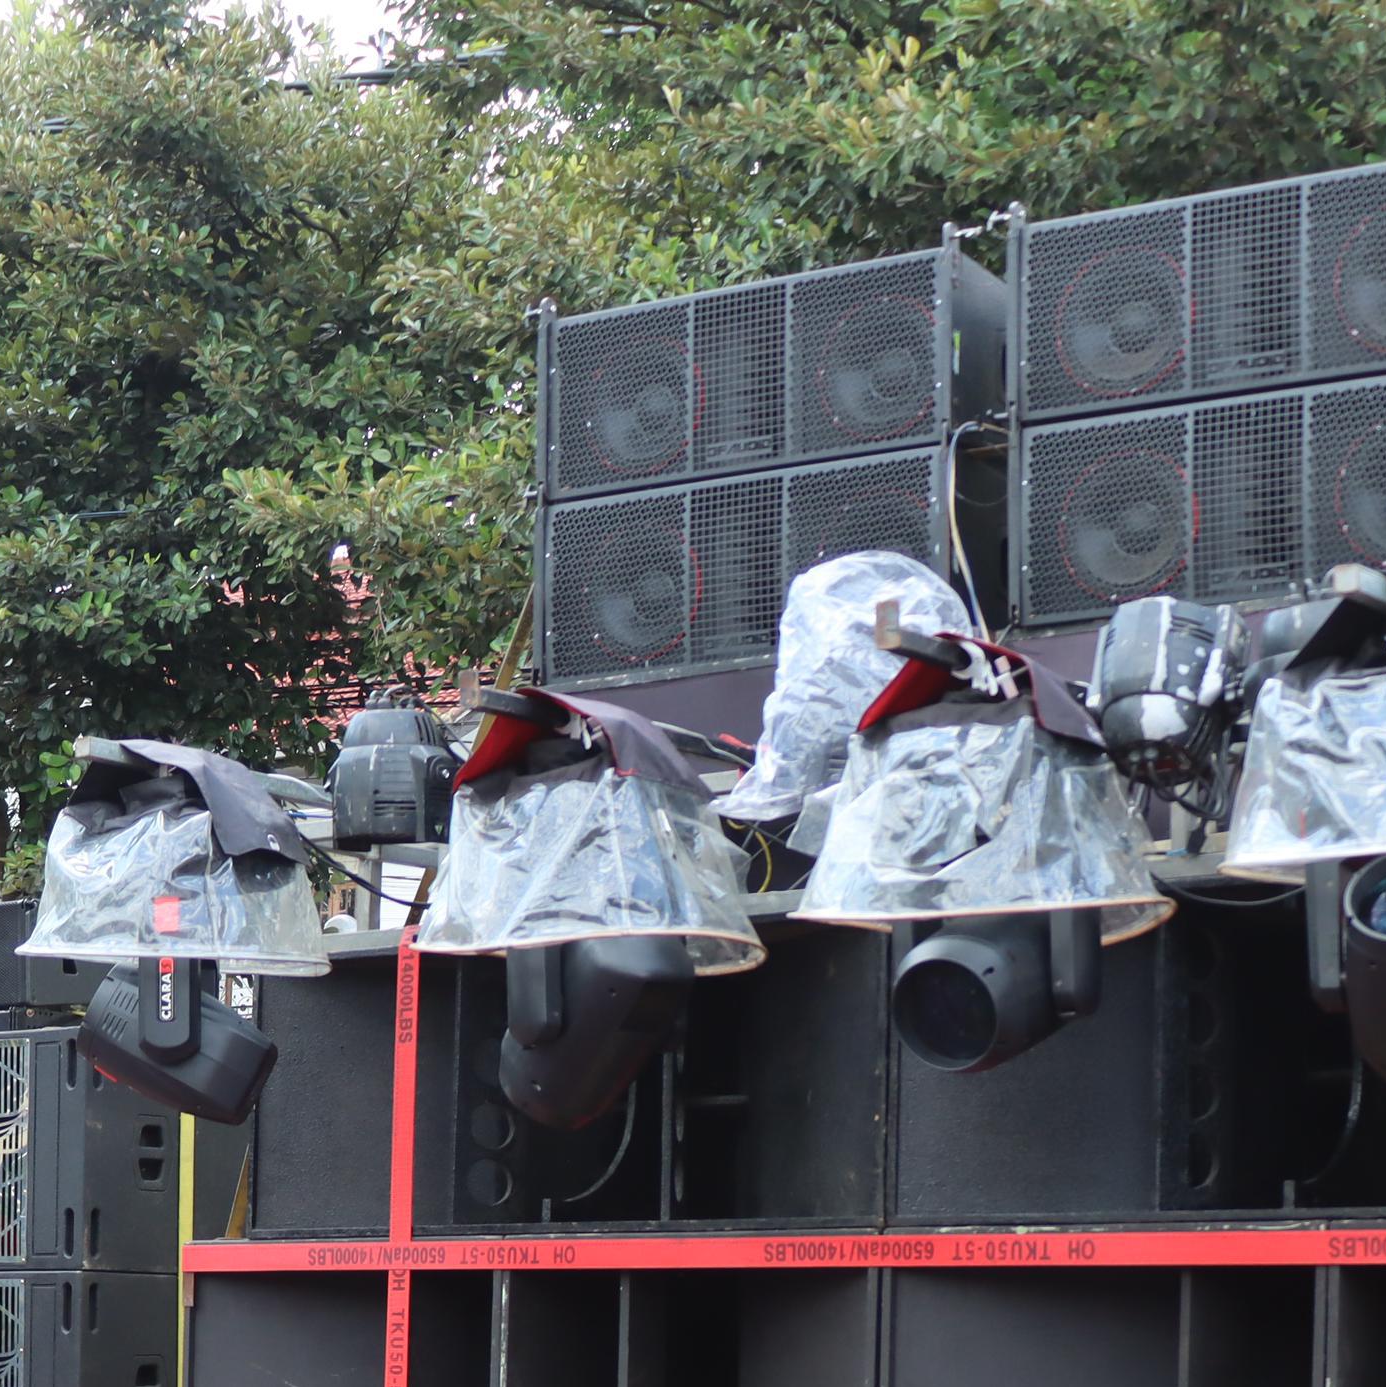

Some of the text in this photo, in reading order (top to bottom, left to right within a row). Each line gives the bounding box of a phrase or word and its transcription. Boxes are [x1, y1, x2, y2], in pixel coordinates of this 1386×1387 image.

[161, 972, 172, 1020] CLARA
[308, 1245, 576, 1266] OH TKU50-5T 6500daN/14000LBS
[764, 1239, 1095, 1263] OH TKU50-5T 6500daN/14000LBS
